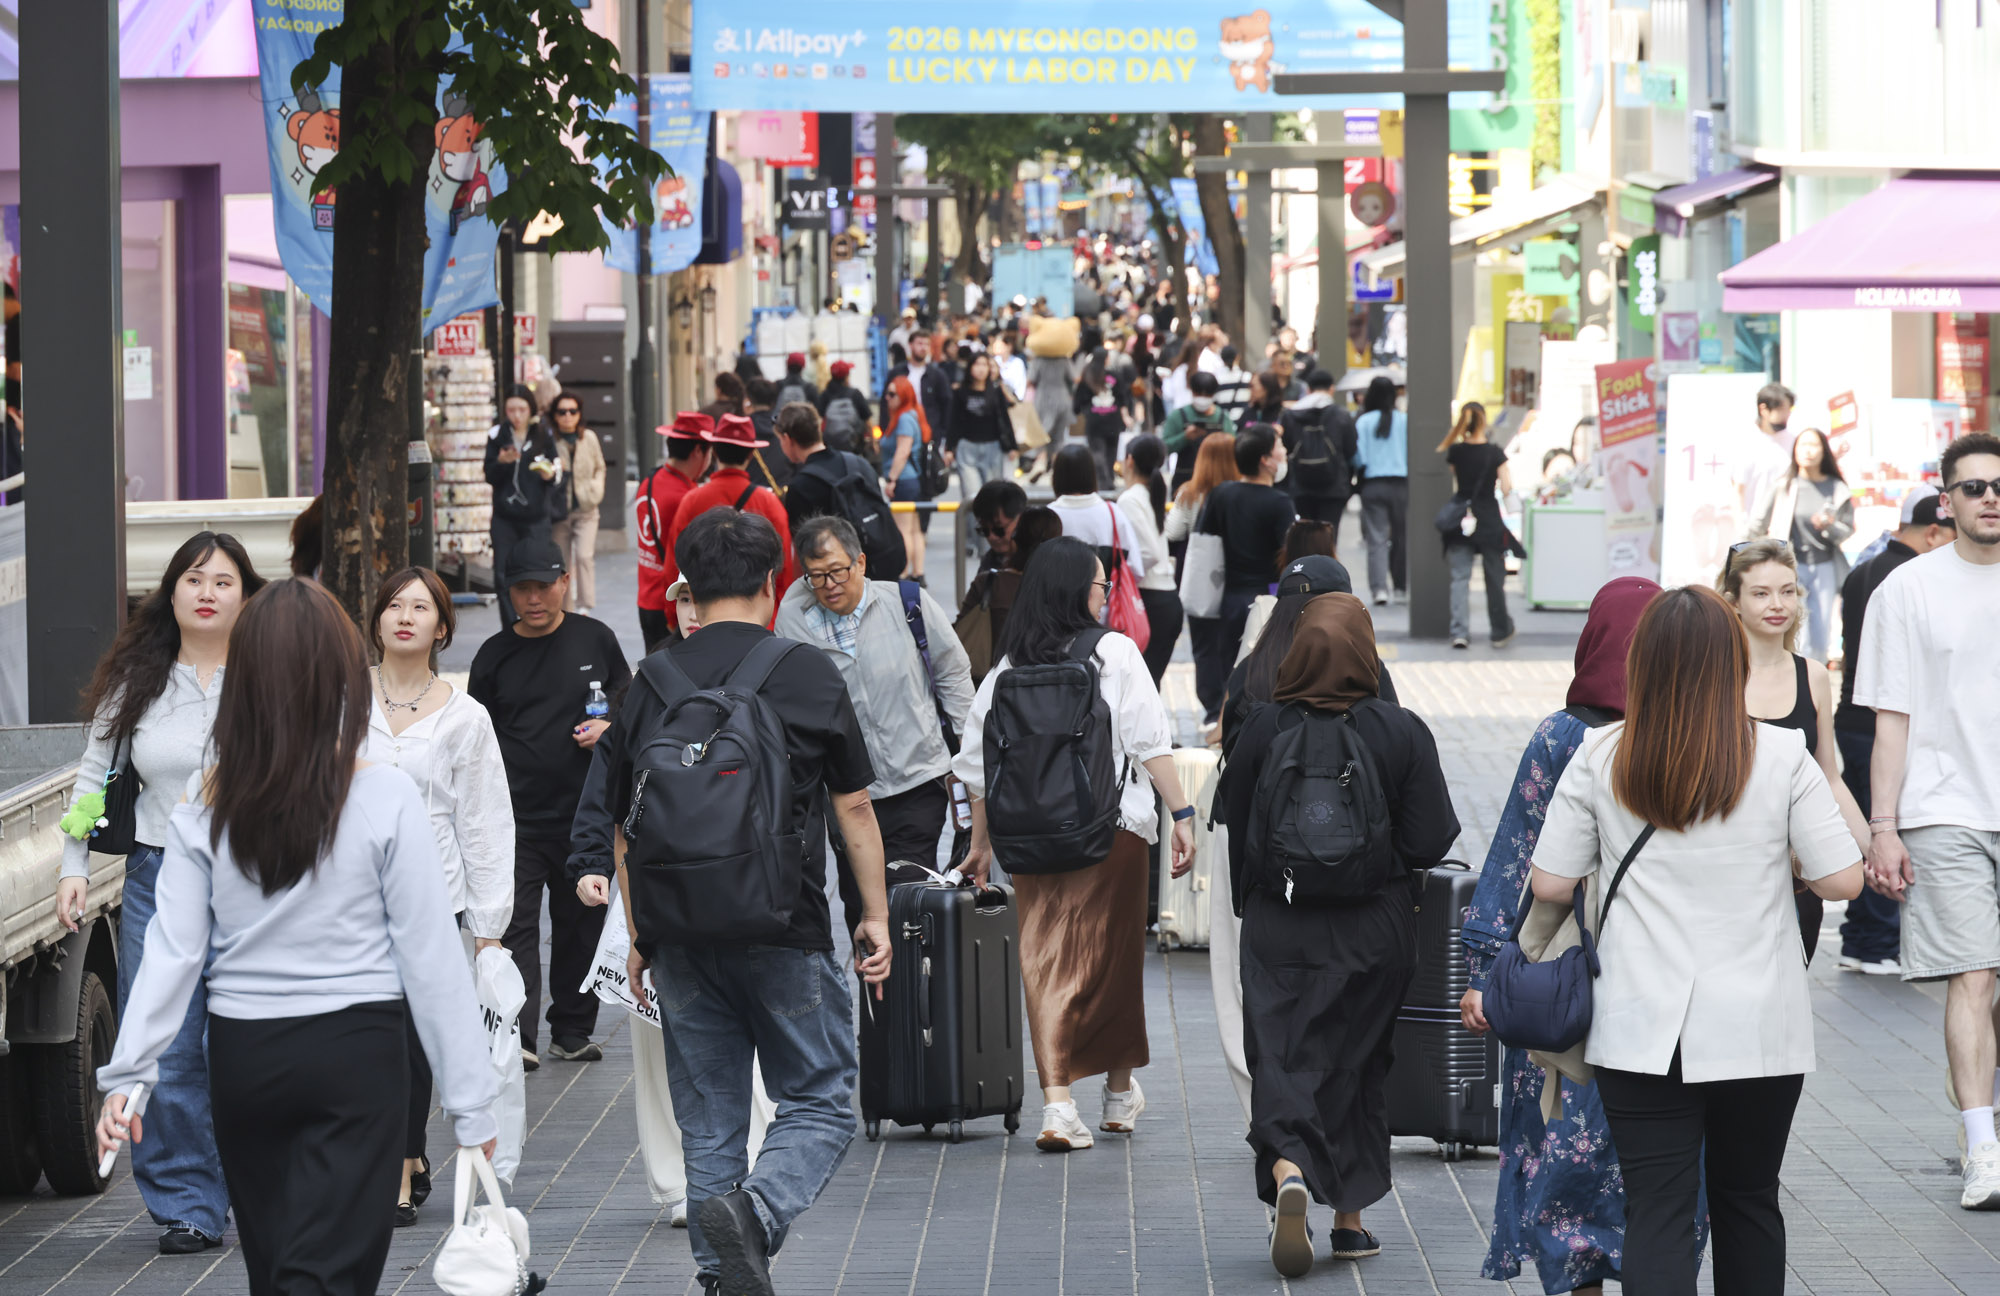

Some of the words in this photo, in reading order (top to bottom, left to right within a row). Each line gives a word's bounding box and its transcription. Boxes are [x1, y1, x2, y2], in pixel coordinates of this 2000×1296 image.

[887, 26, 961, 52] 2026
[968, 27, 1198, 52] MYEONGDONG
[887, 56, 998, 83] LUCKY
[1006, 56, 1118, 83] LABOR
[1125, 56, 1198, 83] DAY
[1855, 288, 1908, 306] HOLIKA
[1908, 288, 1961, 306] HOLIKA
[1600, 371, 1643, 398] Foot
[1602, 391, 1651, 421] Stick
[597, 965, 627, 986] NEW
